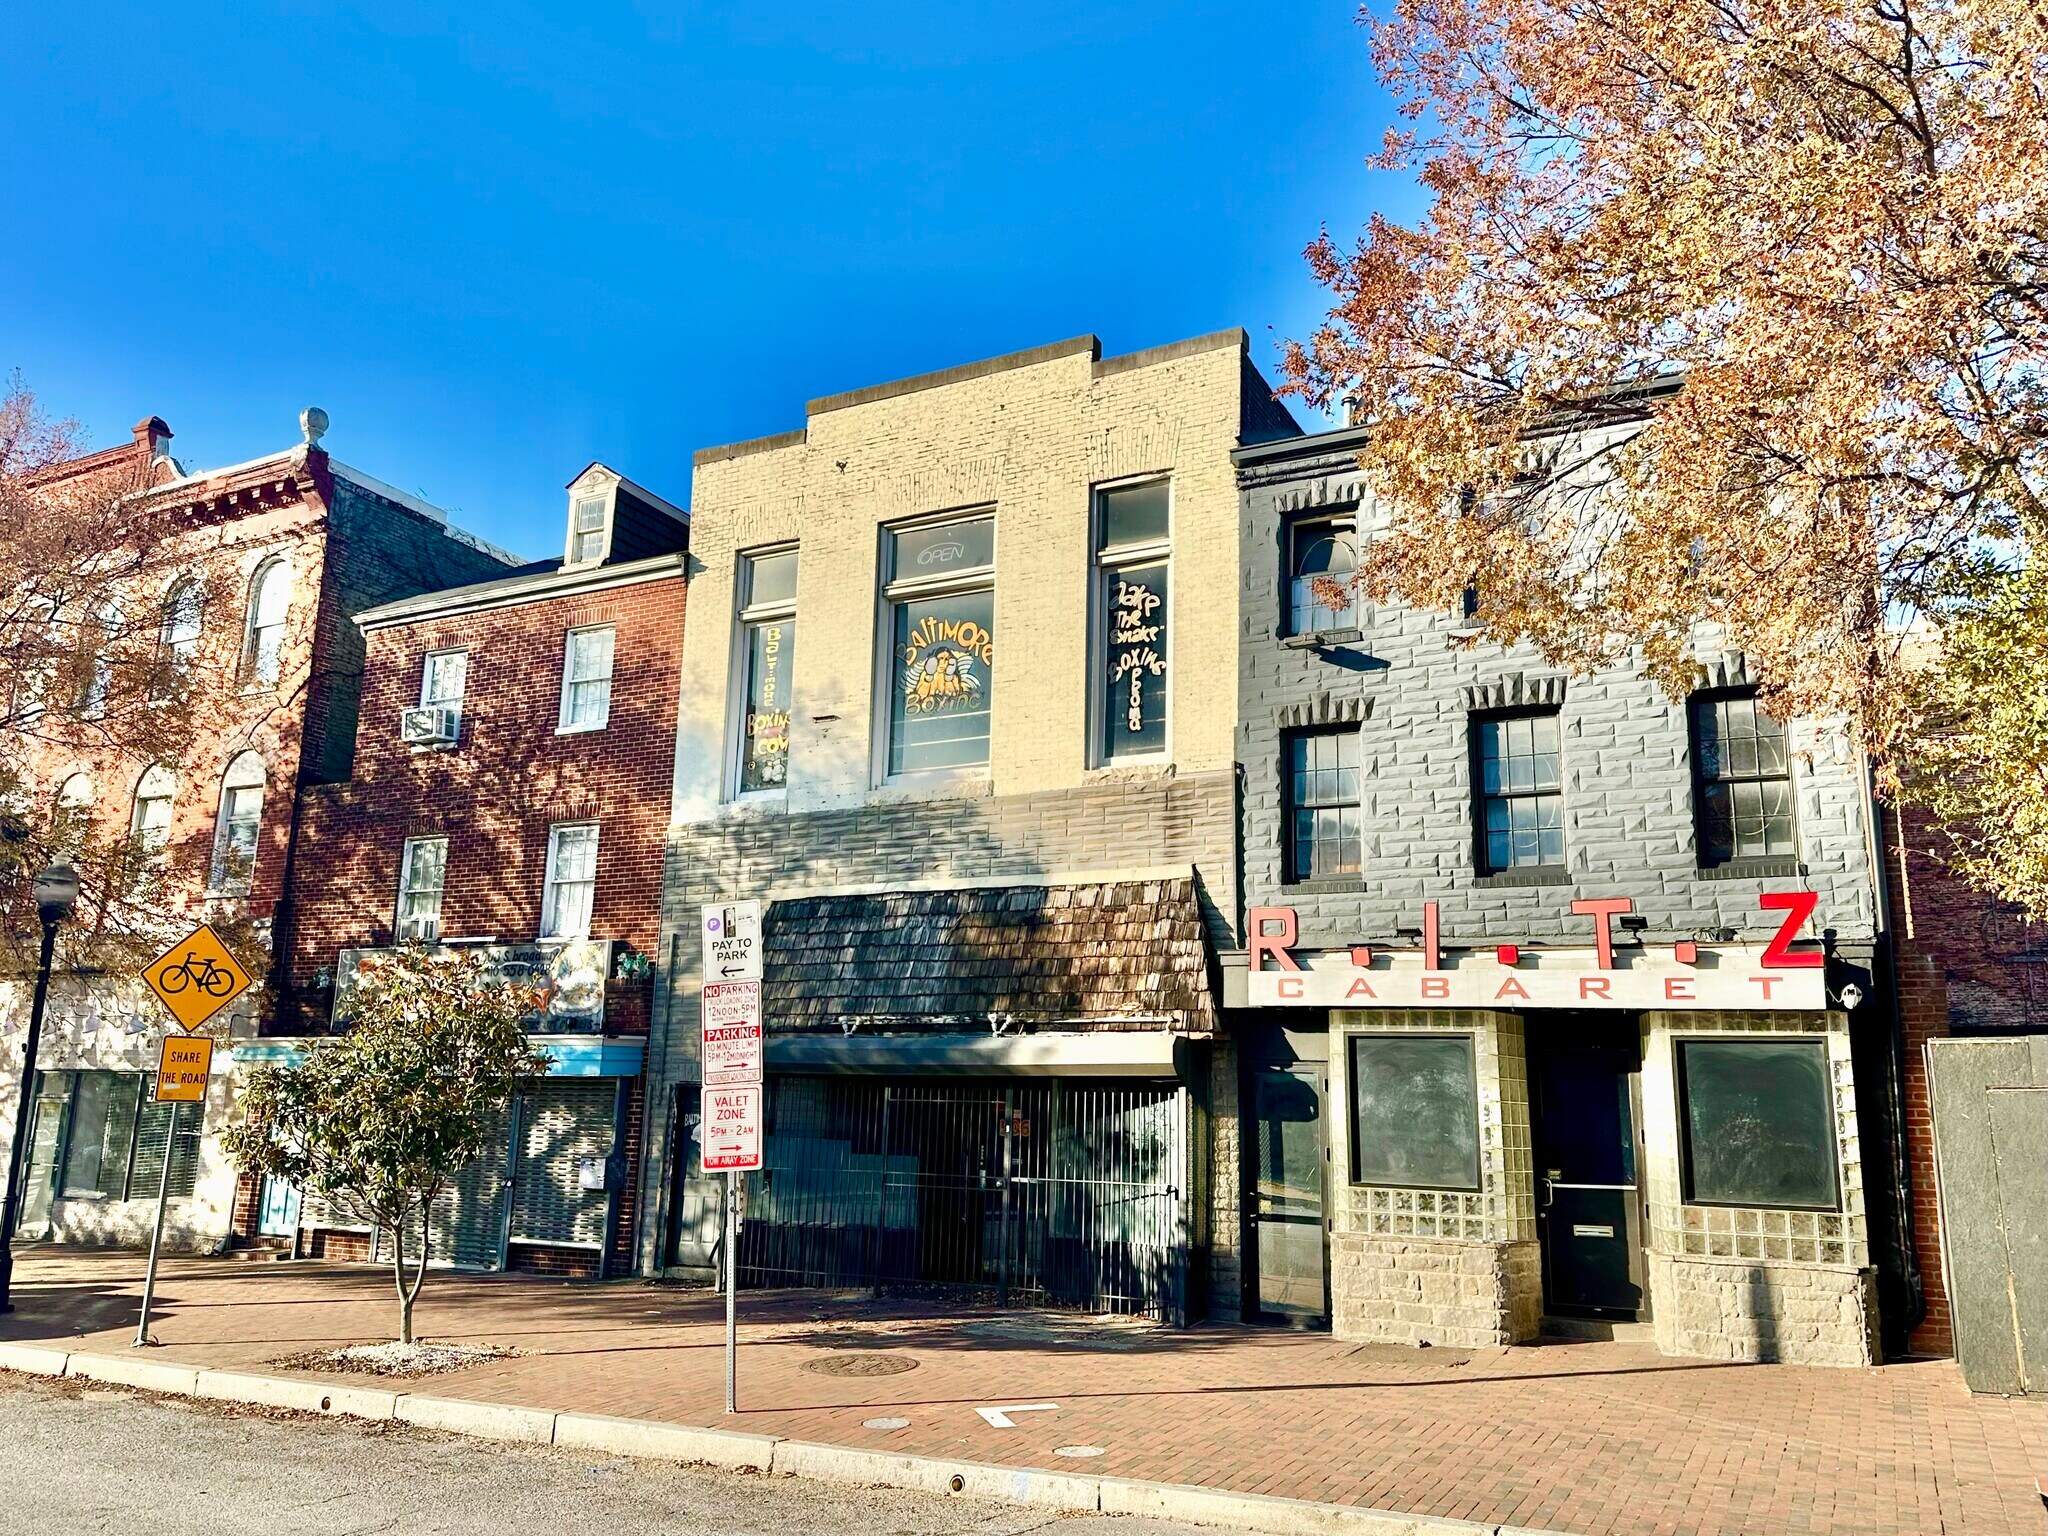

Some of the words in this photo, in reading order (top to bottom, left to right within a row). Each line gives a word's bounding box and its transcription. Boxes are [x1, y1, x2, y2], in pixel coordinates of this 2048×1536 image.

[919, 544, 965, 565] OPEN
[1109, 581, 1161, 617] Jake
[712, 940, 734, 951] PAY
[737, 938, 752, 948] TO
[717, 950, 748, 962] PARK
[705, 986, 719, 998] NO
[721, 983, 757, 996] PARKING
[1277, 977, 1784, 1001] CABARET
[708, 998, 723, 1006] TRUCK
[723, 997, 743, 1005] LOADING
[744, 995, 757, 1003] ZONE
[707, 1027, 757, 1041] PARKING
[707, 1043, 716, 1052] 10
[716, 1041, 740, 1051] MINUTE
[741, 1039, 757, 1050] LIMIT
[171, 1052, 201, 1064] SHARE
[161, 1073, 176, 1084] THE
[181, 1073, 206, 1084] ROAD
[708, 1073, 730, 1083] PASSENGER
[731, 1071, 747, 1081] LOADING
[747, 1070, 758, 1080] ZONE
[714, 1095, 749, 1107] VALET
[716, 1108, 746, 1120] ZONE
[710, 1126, 727, 1138] 5PM
[706, 1156, 719, 1166] TOW
[721, 1155, 738, 1165] AWAY
[739, 1154, 757, 1164] ZONE
